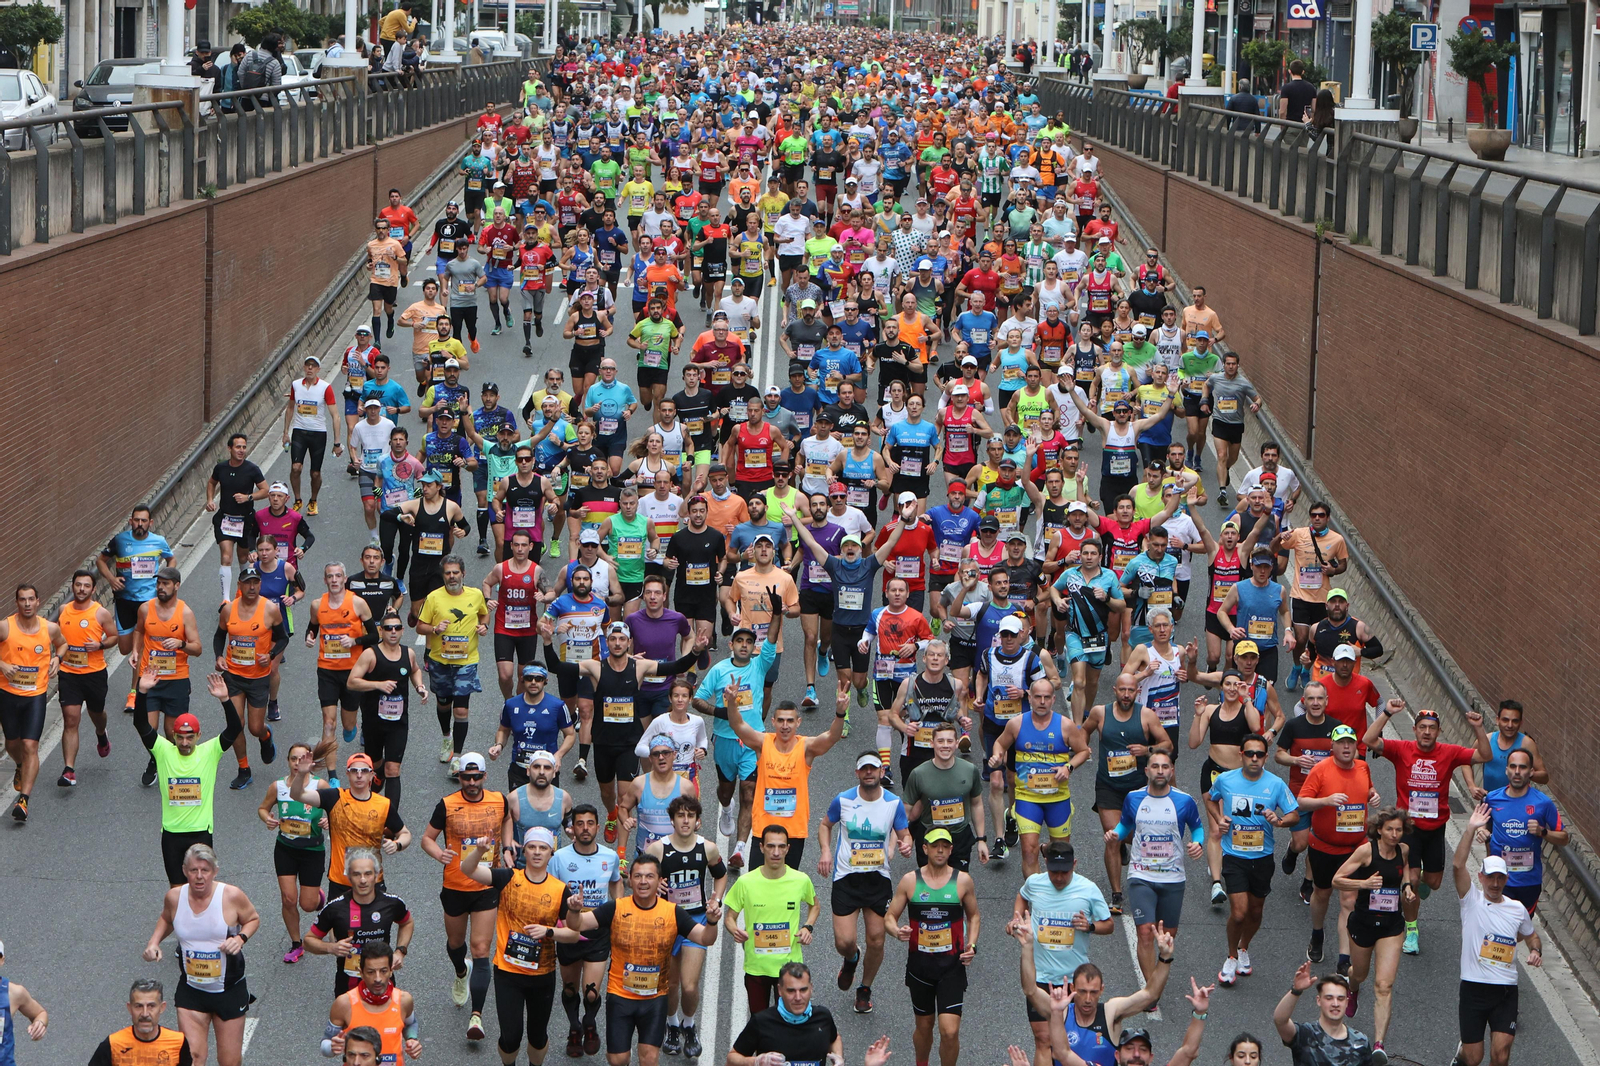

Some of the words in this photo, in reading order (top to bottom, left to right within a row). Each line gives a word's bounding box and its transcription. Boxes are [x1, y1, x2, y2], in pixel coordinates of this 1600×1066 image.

[1416, 28, 1432, 48] P
[718, 353, 731, 364] 26
[507, 589, 525, 598] 360
[1501, 821, 1524, 830] capital
[520, 935, 538, 944] ZURICH
